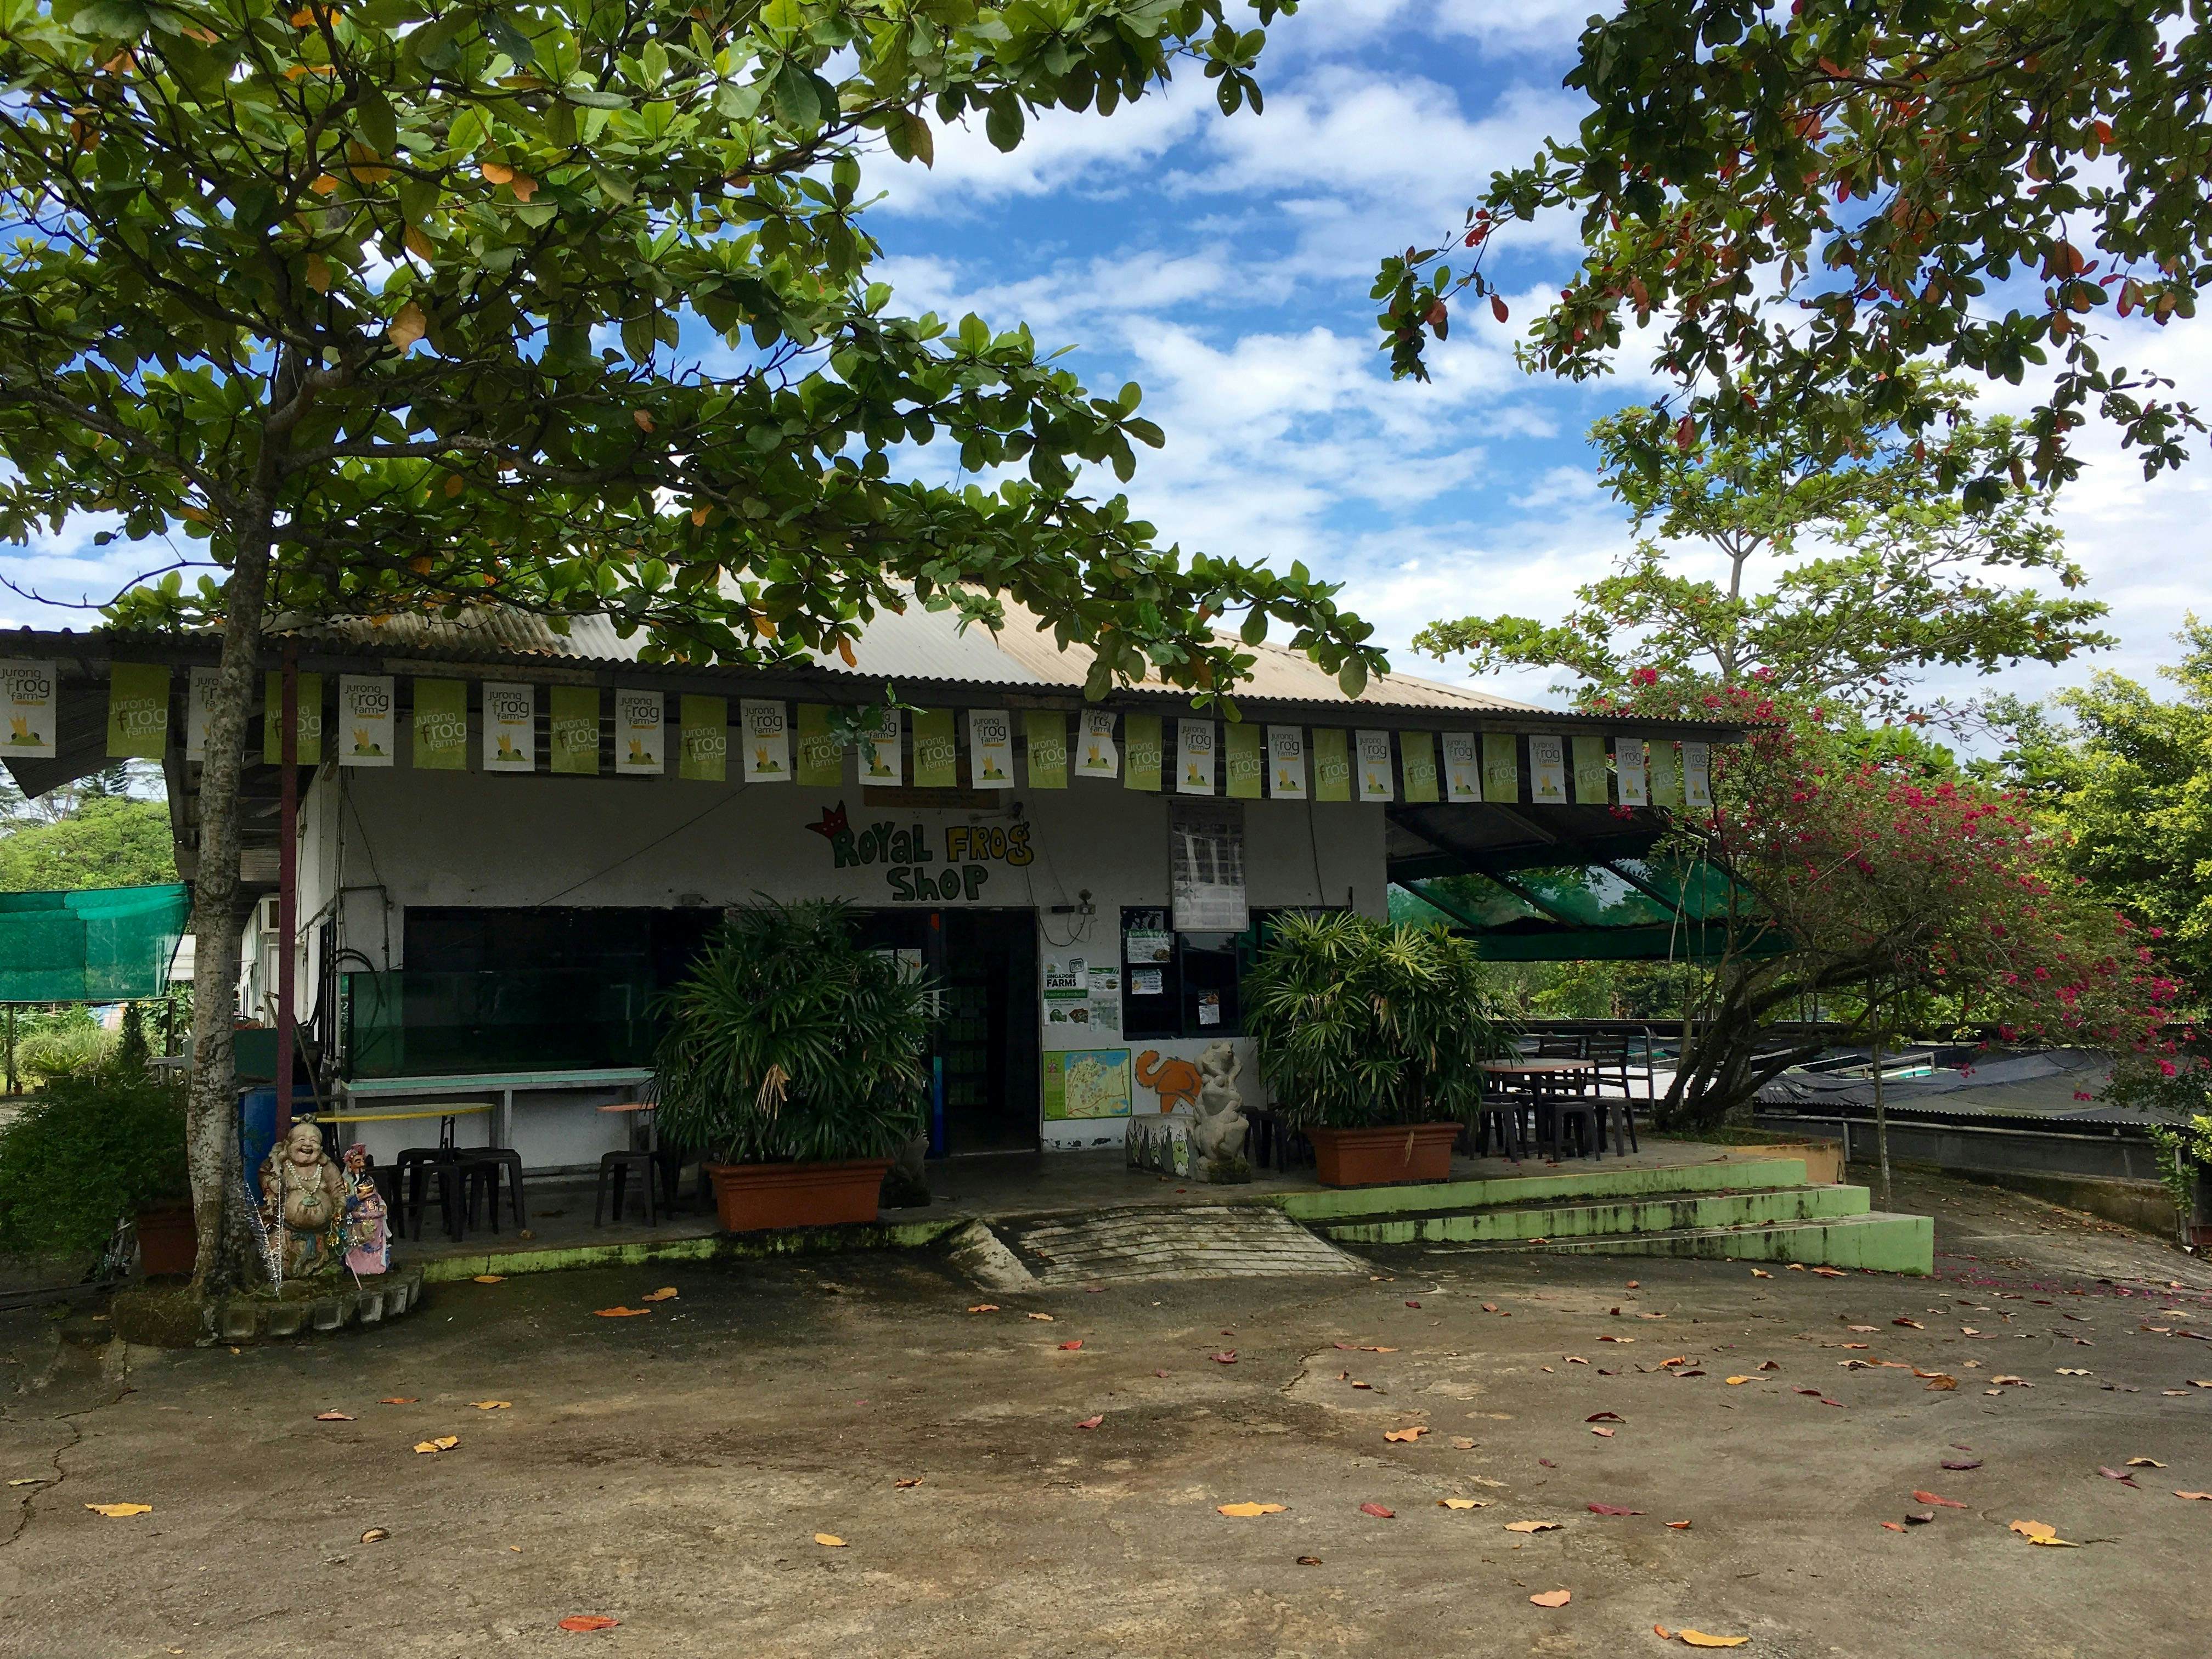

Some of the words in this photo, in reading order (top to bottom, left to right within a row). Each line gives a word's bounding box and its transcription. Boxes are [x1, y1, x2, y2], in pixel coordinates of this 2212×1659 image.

[5, 677, 50, 698] frog
[196, 677, 218, 686] juro
[12, 691, 38, 701] farm
[200, 686, 218, 702] fr
[345, 685, 381, 695] jurong
[488, 691, 522, 701] jurong
[110, 697, 156, 714] jurong
[348, 693, 388, 711] frog
[492, 699, 529, 718] frog
[620, 697, 652, 707] jurong
[354, 707, 378, 715] farm
[624, 705, 659, 723] frog
[744, 707, 775, 716] jurong
[117, 708, 167, 731] frog
[272, 716, 321, 738] fog
[414, 712, 456, 728] jurong
[551, 718, 590, 734] jurong
[628, 718, 650, 726] farm
[748, 715, 783, 732] frog
[973, 717, 1000, 727] jurong
[125, 726, 156, 738] farm
[421, 722, 466, 744] frog
[557, 727, 599, 748] frog
[681, 727, 716, 738] jurong
[977, 725, 1006, 741] frog
[1181, 726, 1206, 734] jurong
[429, 740, 456, 751] farm
[566, 743, 591, 754] farm
[686, 736, 726, 758] frog
[913, 736, 946, 751] jurong
[1028, 739, 1058, 753] jurong
[1126, 742, 1153, 754] jurong
[1186, 733, 1211, 749] frog
[1274, 740, 1299, 755] frog
[693, 753, 718, 762] farm
[803, 742, 843, 763] frog
[918, 745, 956, 766] frog
[1032, 747, 1067, 768] frog
[1363, 744, 1386, 759] frog
[1449, 746, 1471, 760] frog
[1536, 749, 1560, 763] frog
[1622, 752, 1641, 765] frog
[810, 758, 835, 769] farm
[926, 760, 947, 771] farm
[1040, 762, 1061, 772] farm
[1128, 751, 1161, 769] frog
[1228, 759, 1261, 777] frog
[1319, 762, 1348, 781] frog
[1407, 763, 1437, 782] frog
[1487, 766, 1517, 784] frog
[1235, 772, 1254, 782] farm
[1325, 776, 1343, 786] farm
[1578, 769, 1607, 785] frog
[1046, 979, 1076, 987] FARMS
